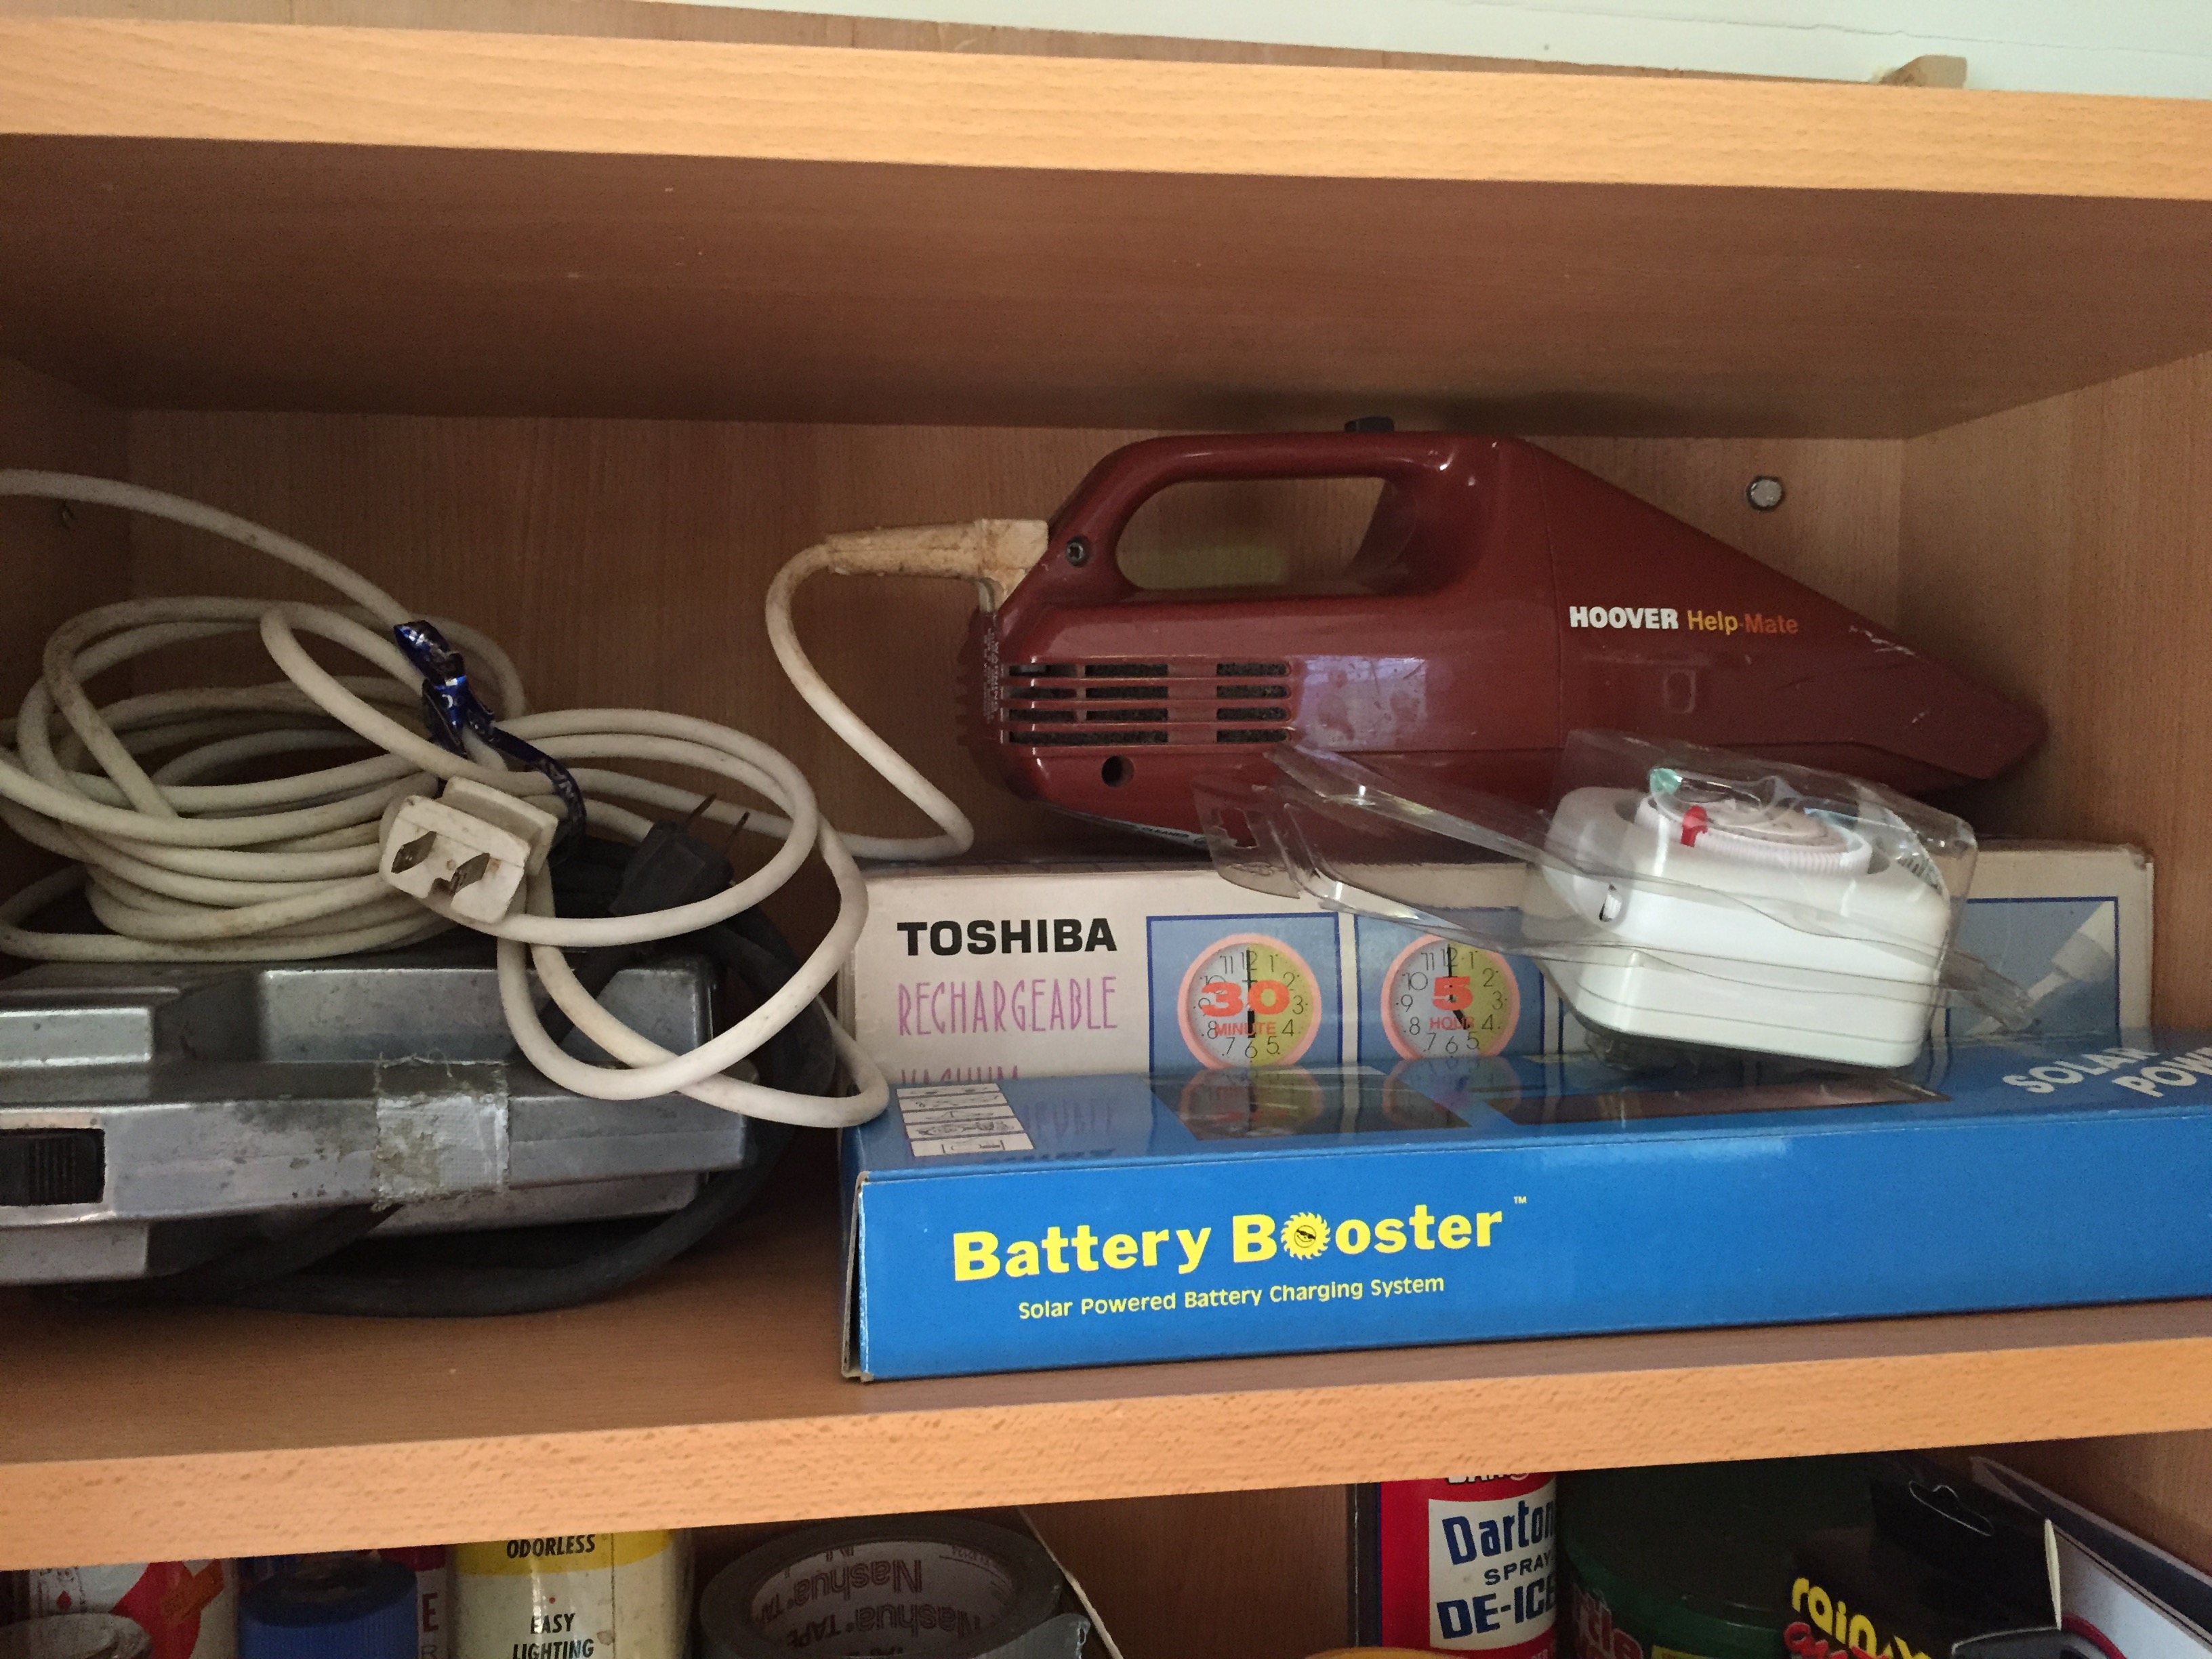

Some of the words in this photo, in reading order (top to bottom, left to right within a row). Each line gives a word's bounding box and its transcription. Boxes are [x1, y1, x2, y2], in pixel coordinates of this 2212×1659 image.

[1569, 605, 1679, 630] HOOVER
[897, 918, 1118, 956] TOSHIBA
[1222, 956, 1233, 974] 11
[1269, 955, 1275, 972] 1
[1422, 952, 1435, 970] 11
[1440, 947, 1458, 967] 12
[1469, 951, 1475, 969] 1
[1282, 971, 1296, 991] 2
[1406, 971, 1428, 991] 10
[1482, 968, 1495, 987] 2
[1201, 979, 1290, 1017] 30
[1400, 994, 1414, 1012] 9
[1432, 976, 1473, 1011] 5
[1492, 990, 1503, 1010] 3
[897, 976, 1118, 1036] RECHARGEABLE
[1292, 995, 1304, 1015] 3
[1206, 1020, 1218, 1040] 8
[1281, 1019, 1294, 1037] 4
[1409, 1017, 1420, 1036] 8
[1481, 1014, 1494, 1031] 4
[1226, 1037, 1235, 1055] 7
[1244, 1040, 1258, 1059] 6
[1266, 1036, 1280, 1054] 5
[1427, 1032, 1437, 1050] 7
[1445, 1036, 1458, 1054] 6
[1466, 1031, 1479, 1050] 5
[2002, 1047, 2160, 1094] SOLAR
[953, 1224, 1212, 1282] Battery
[1018, 1300, 1073, 1319] Solar
[1081, 1292, 1176, 1315] Powered
[1184, 1287, 1262, 1309] Battery
[1269, 1281, 1364, 1302] Charging
[1371, 1277, 1445, 1297] System
[506, 1534, 596, 1559] ODORLESS
[530, 1613, 576, 1635] EASY
[512, 1638, 594, 1659] LIGHTING
